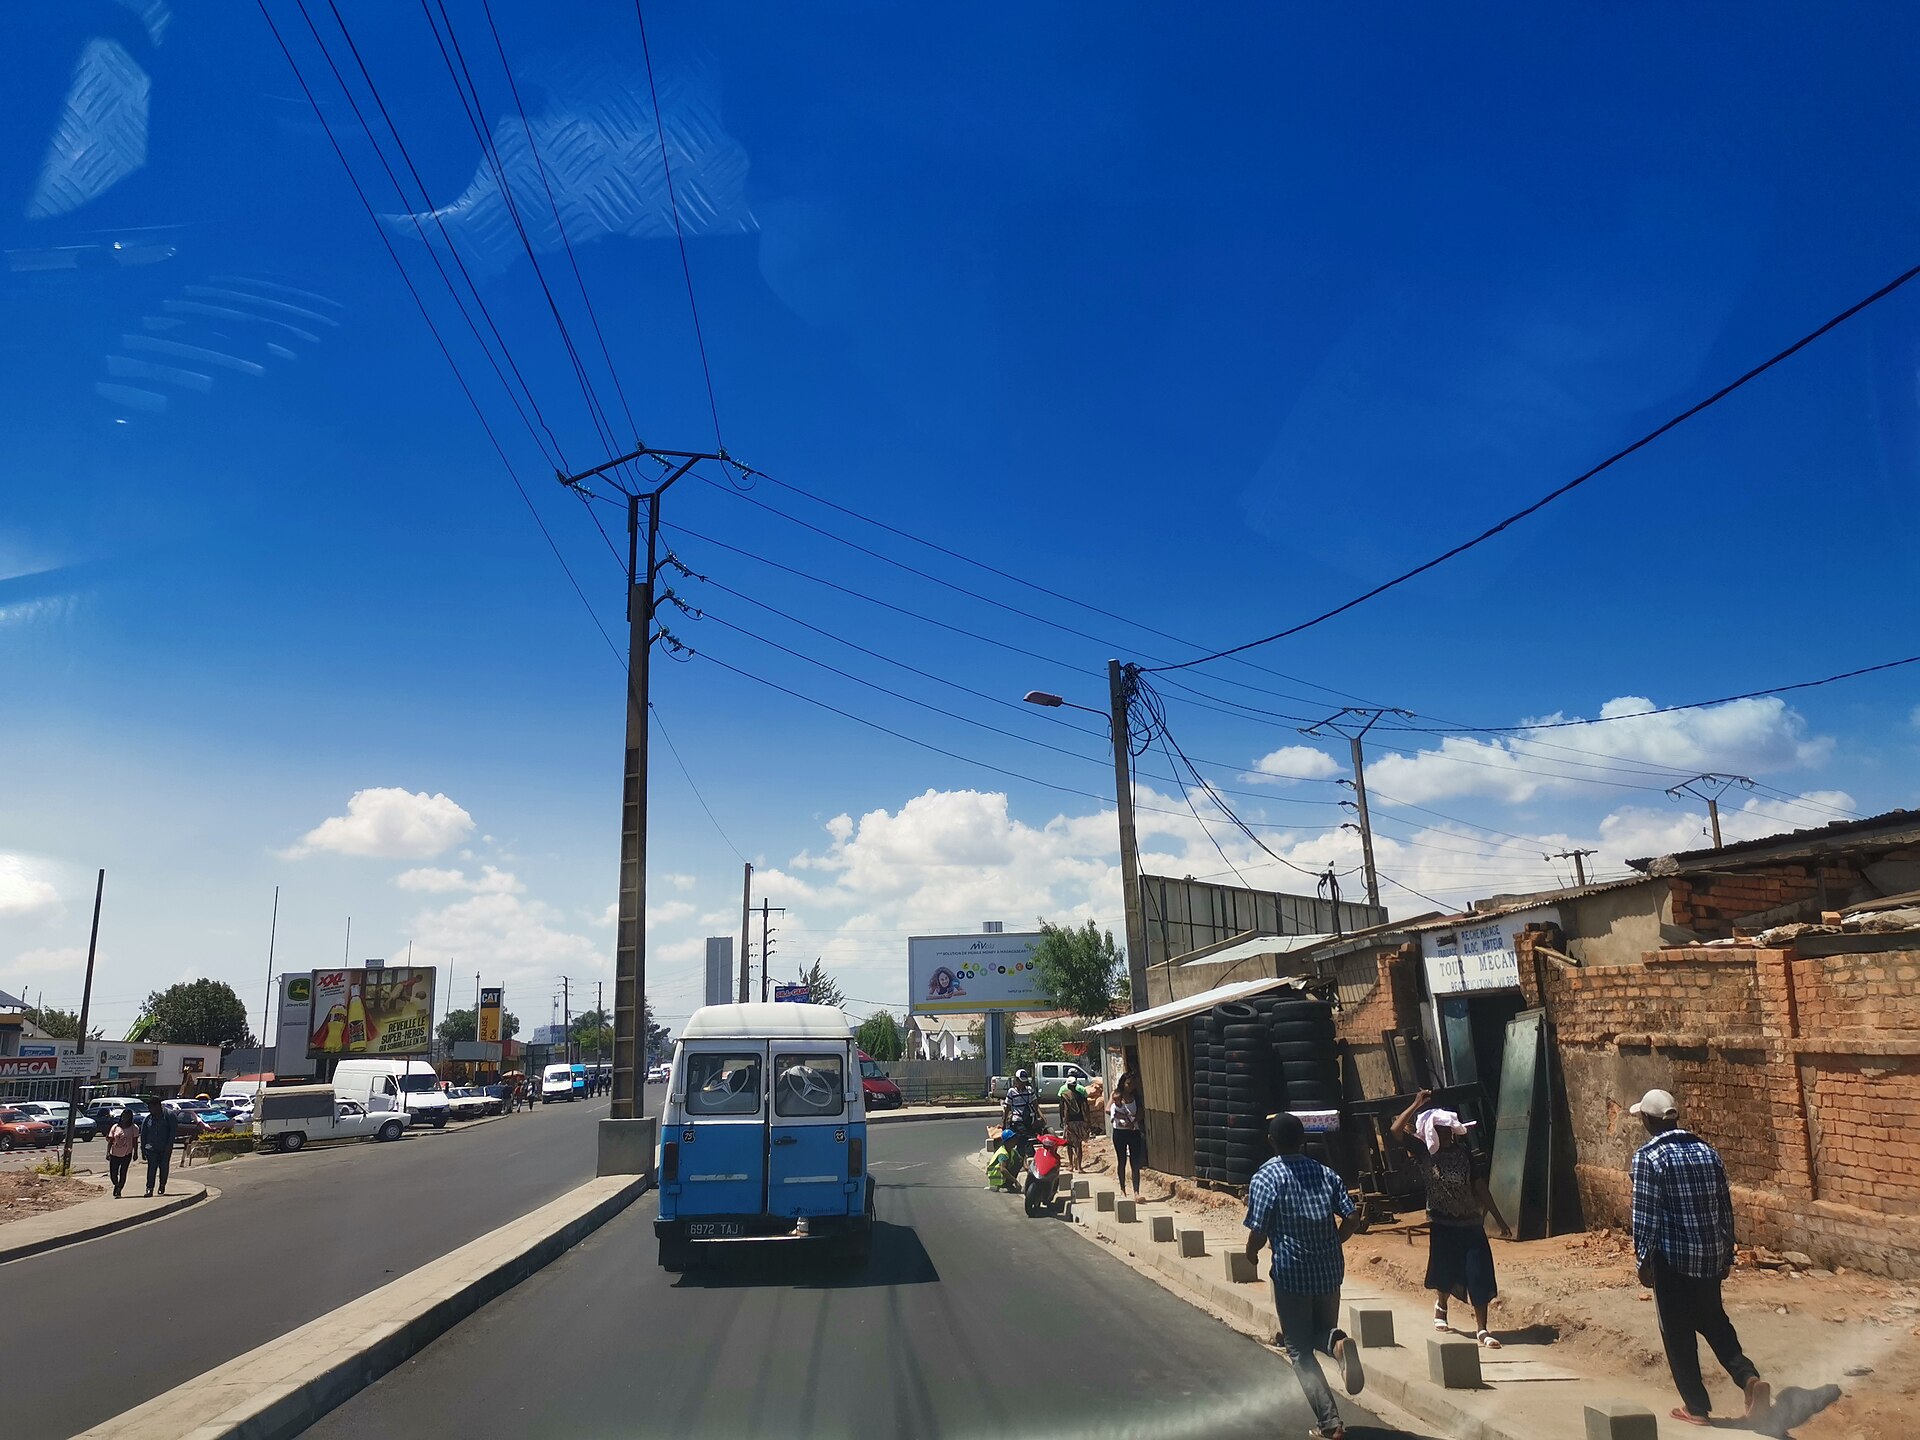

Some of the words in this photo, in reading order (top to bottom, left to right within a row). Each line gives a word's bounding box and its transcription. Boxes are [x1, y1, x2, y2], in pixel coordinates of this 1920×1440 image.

[1463, 942, 1479, 954] BLOC
[1482, 938, 1504, 951] MOTEUR
[1440, 960, 1465, 977] TOUR
[317, 973, 346, 987] XXL
[482, 992, 499, 1003] CAT
[417, 1016, 426, 1026] LE
[0, 1062, 51, 1076] MECA
[690, 1224, 714, 1235] 6972
[720, 1224, 739, 1235] TAJ
